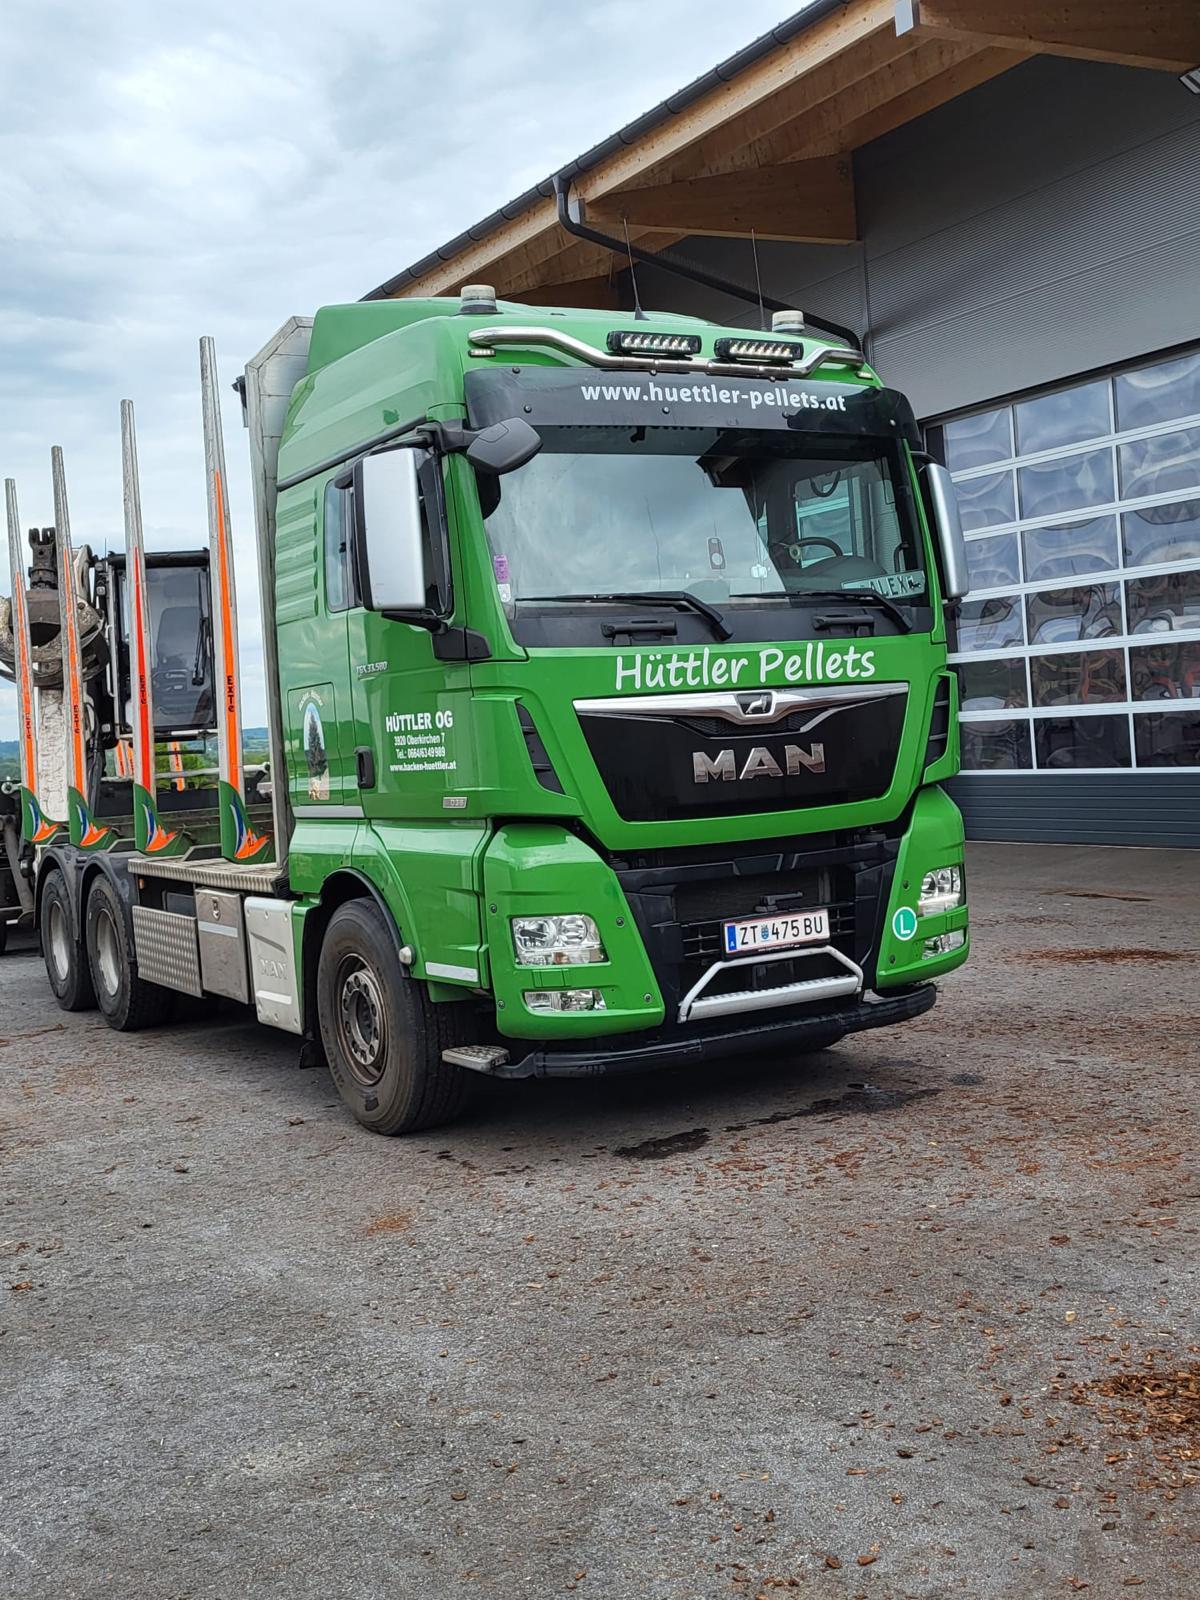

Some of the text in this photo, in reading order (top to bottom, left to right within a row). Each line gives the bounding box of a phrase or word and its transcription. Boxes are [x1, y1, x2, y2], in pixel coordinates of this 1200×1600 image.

[581, 382, 847, 411] www.huettler-pellets.at
[615, 642, 876, 690] Hüttler Pellets
[385, 710, 453, 733] HÜTTLER OG
[692, 742, 826, 783] MAN
[739, 915, 824, 946] ZT 475 BU
[900, 914, 911, 934] L
